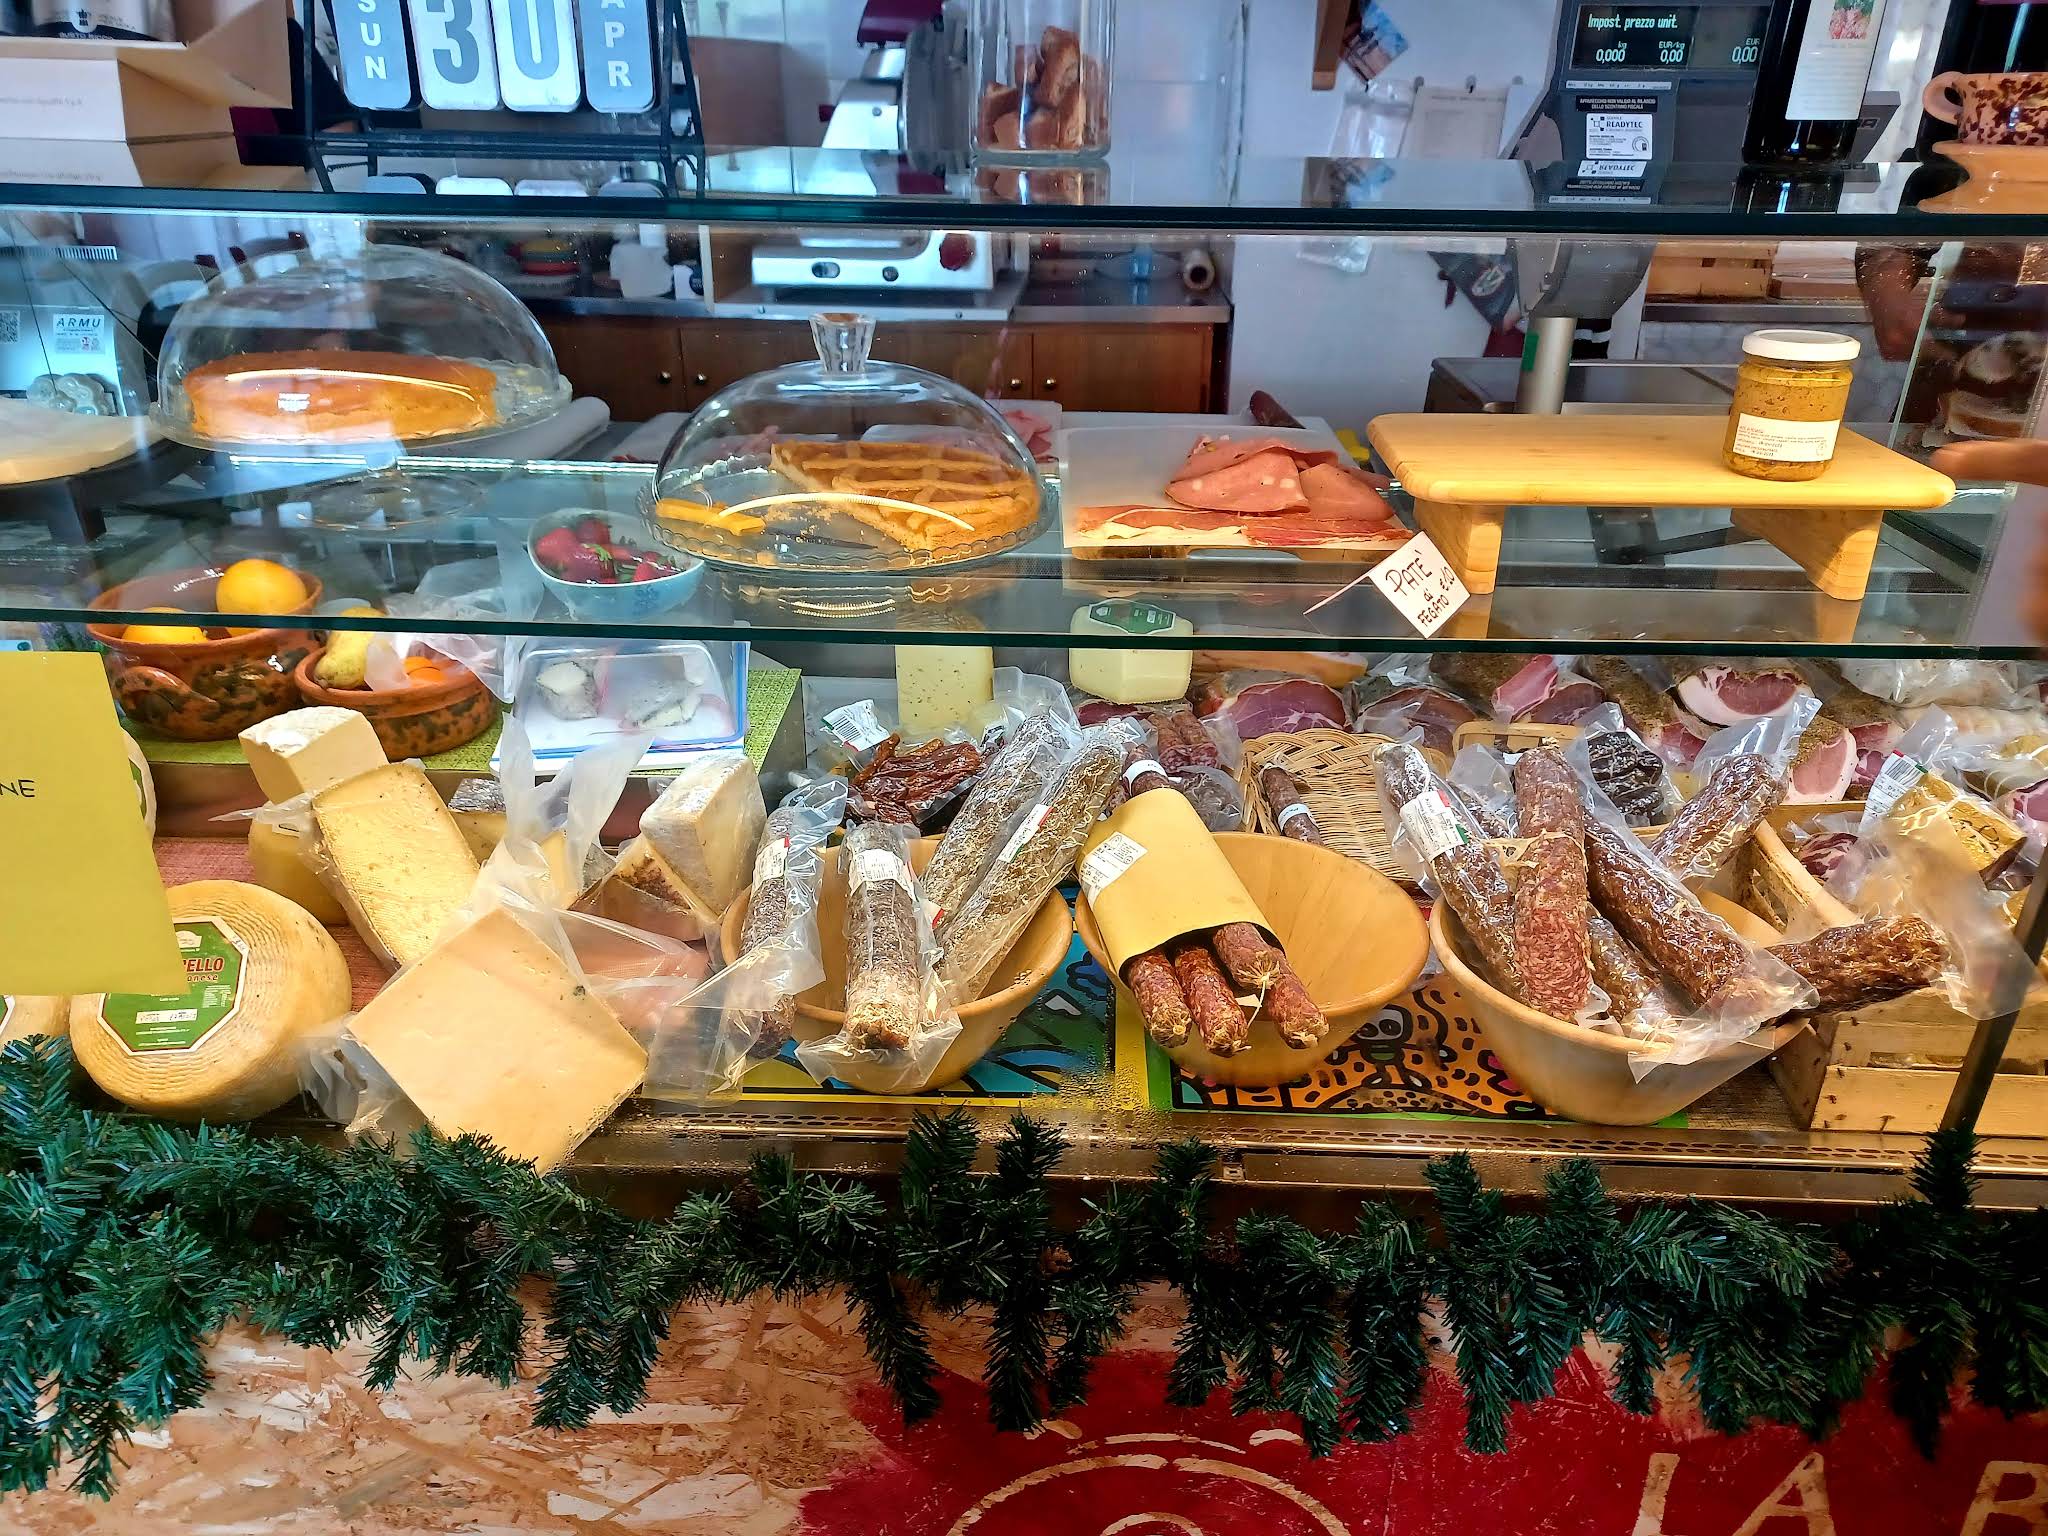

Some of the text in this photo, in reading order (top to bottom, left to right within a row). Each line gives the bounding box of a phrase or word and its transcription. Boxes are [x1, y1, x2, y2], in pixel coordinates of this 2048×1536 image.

[1588, 14, 1678, 31] Impost. prezzo unit.
[1617, 41, 1628, 50] kg
[1658, 41, 1686, 50] EUR/kg
[1745, 37, 1761, 46] EUR
[1595, 49, 1627, 63] 0,000
[1659, 49, 1684, 63] 0,00
[1731, 46, 1759, 63] 0,00
[1606, 120, 1643, 129] READYTEC
[56, 318, 101, 327] ARMU
[1417, 594, 1450, 627] FEGATO
[183, 957, 224, 973] ELLO
